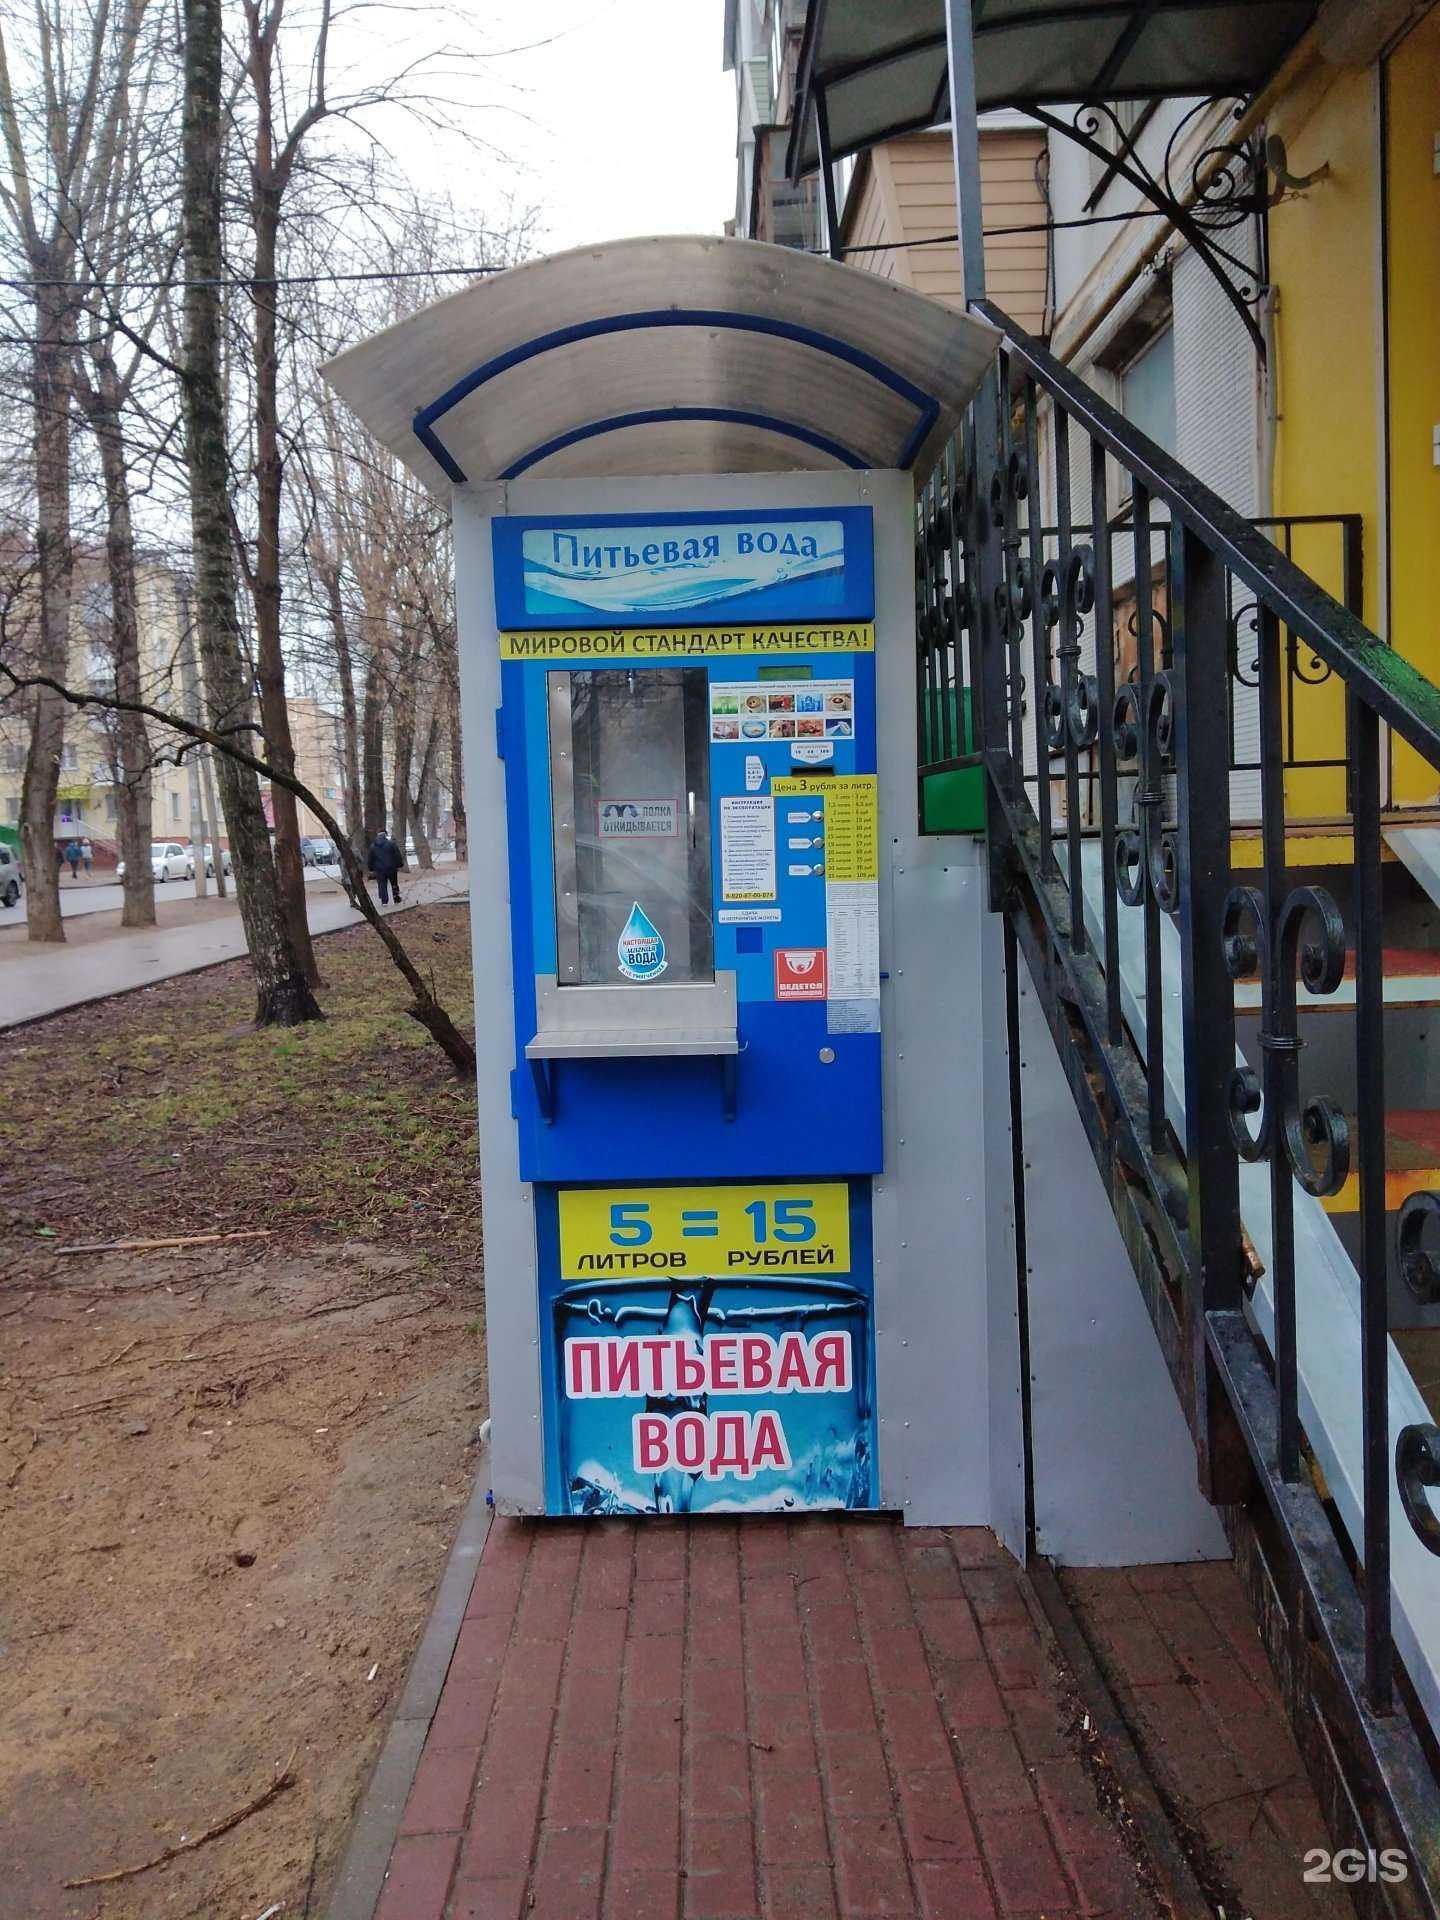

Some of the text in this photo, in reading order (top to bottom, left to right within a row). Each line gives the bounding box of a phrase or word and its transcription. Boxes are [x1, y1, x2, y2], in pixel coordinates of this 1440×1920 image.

[552, 531, 819, 569] Питьевая вода
[509, 630, 868, 655] МИРОВОЙ СТАНДАРТ КАЧЕСТВА!
[774, 783, 797, 792] Цена
[799, 779, 807, 791] 3
[810, 782, 837, 793] рубля
[642, 806, 672, 817] ПОЛКА
[603, 820, 672, 833] ОТКИДЫВАЕТСЯ
[628, 952, 657, 965] ВОДА
[609, 1203, 653, 1247] 5
[744, 1199, 817, 1244] 15
[577, 1244, 835, 1270] ЛИТРОВ РУБЛЕЙ
[569, 1335, 848, 1394] ПИТЬЕВАЯ
[637, 1414, 787, 1477] ВОДА
